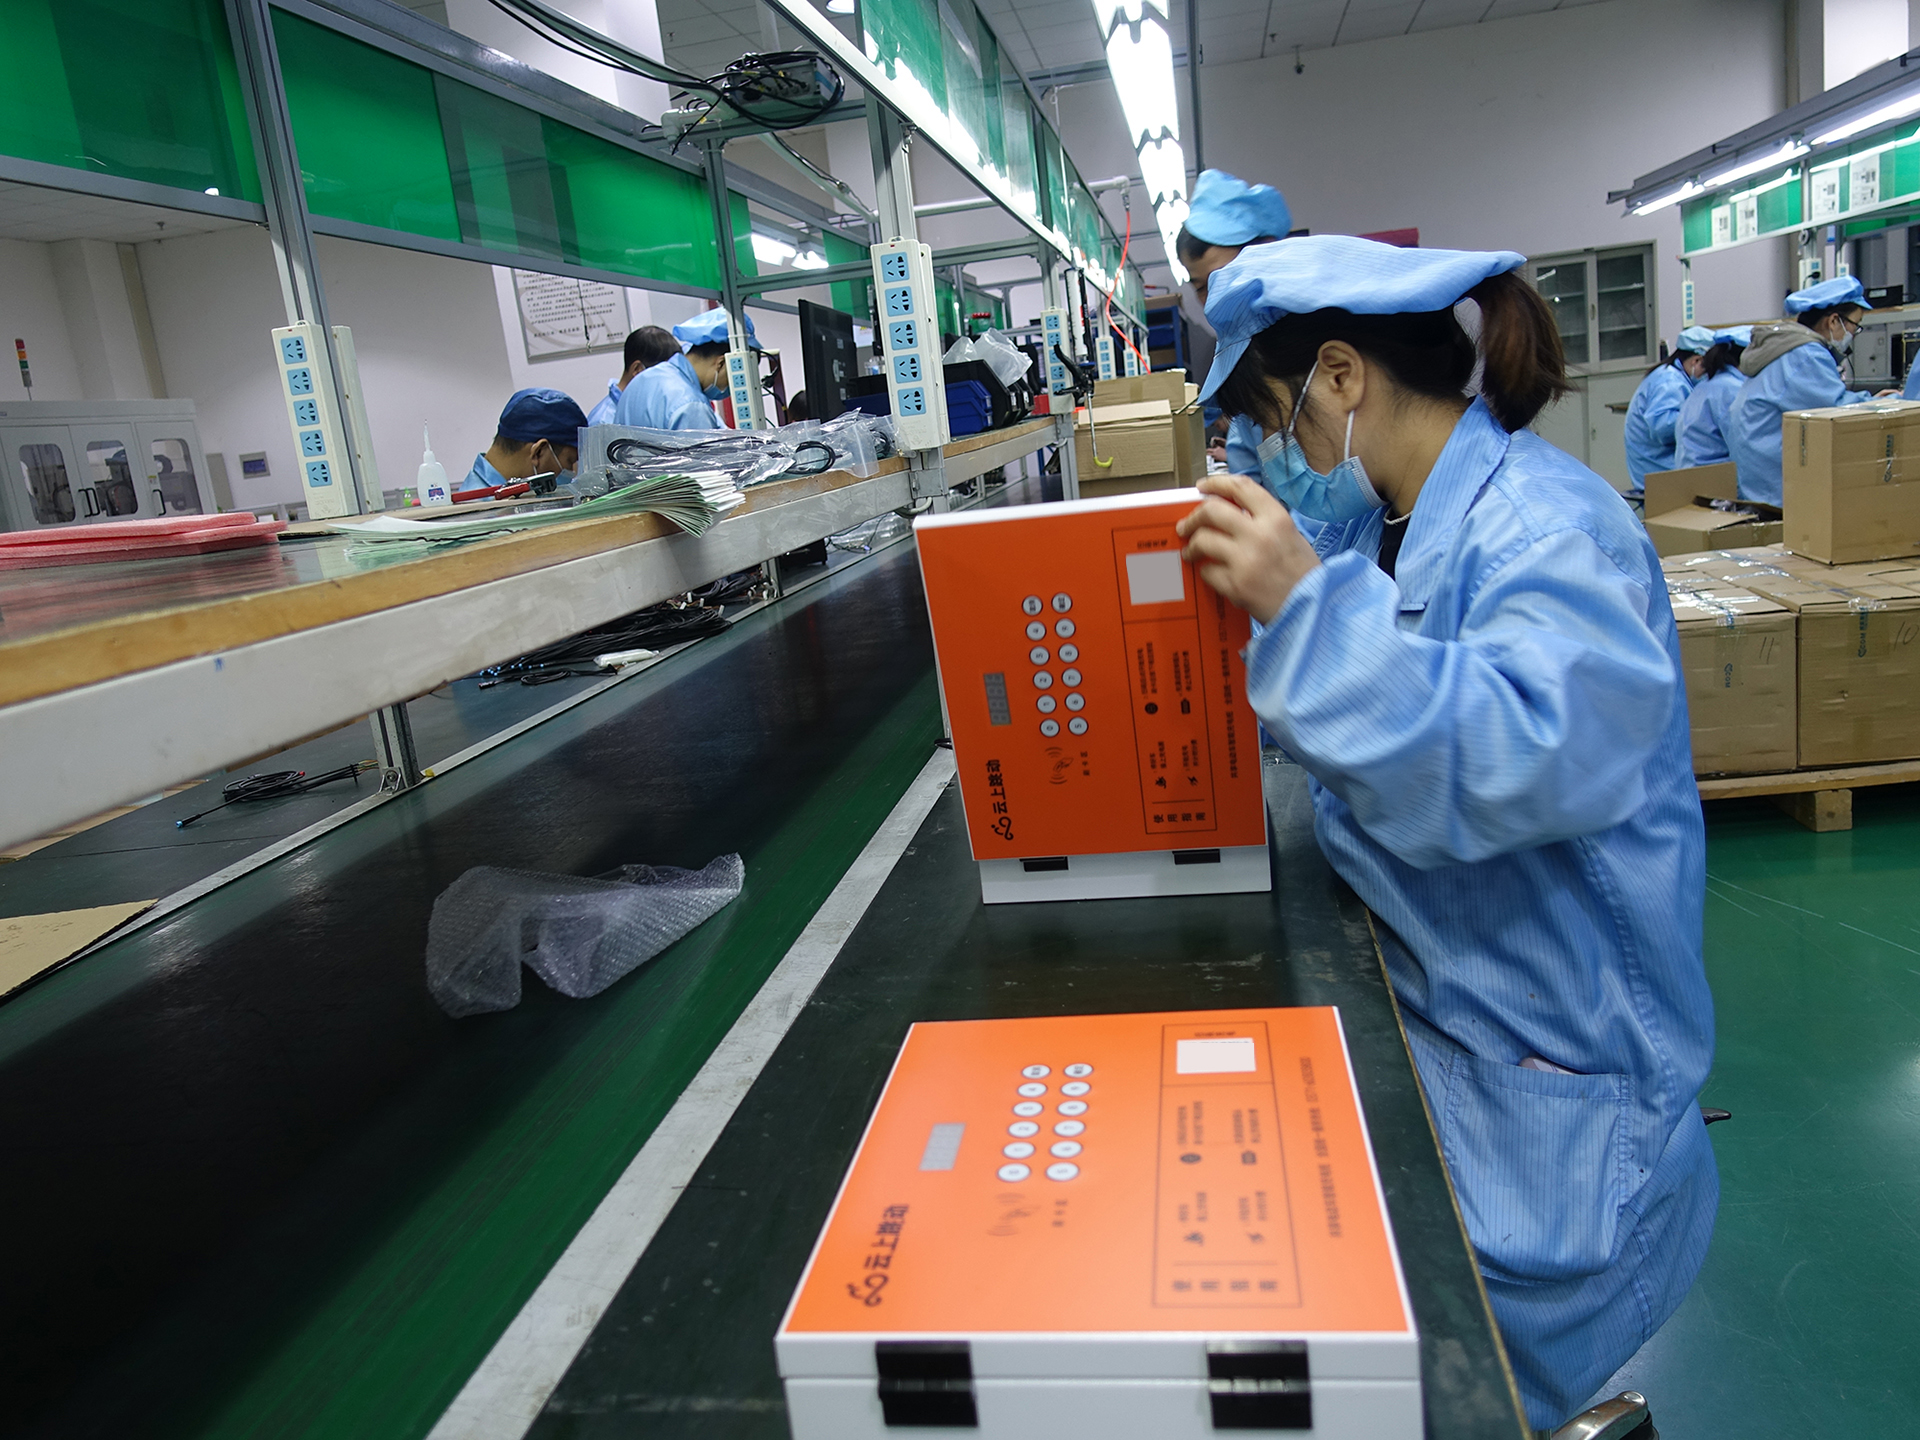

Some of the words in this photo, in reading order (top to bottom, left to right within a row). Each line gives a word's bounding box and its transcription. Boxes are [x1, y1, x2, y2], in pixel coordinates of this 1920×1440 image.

[985, 759, 1008, 814] 云上跳动
[864, 1204, 909, 1270] 云上跳动
